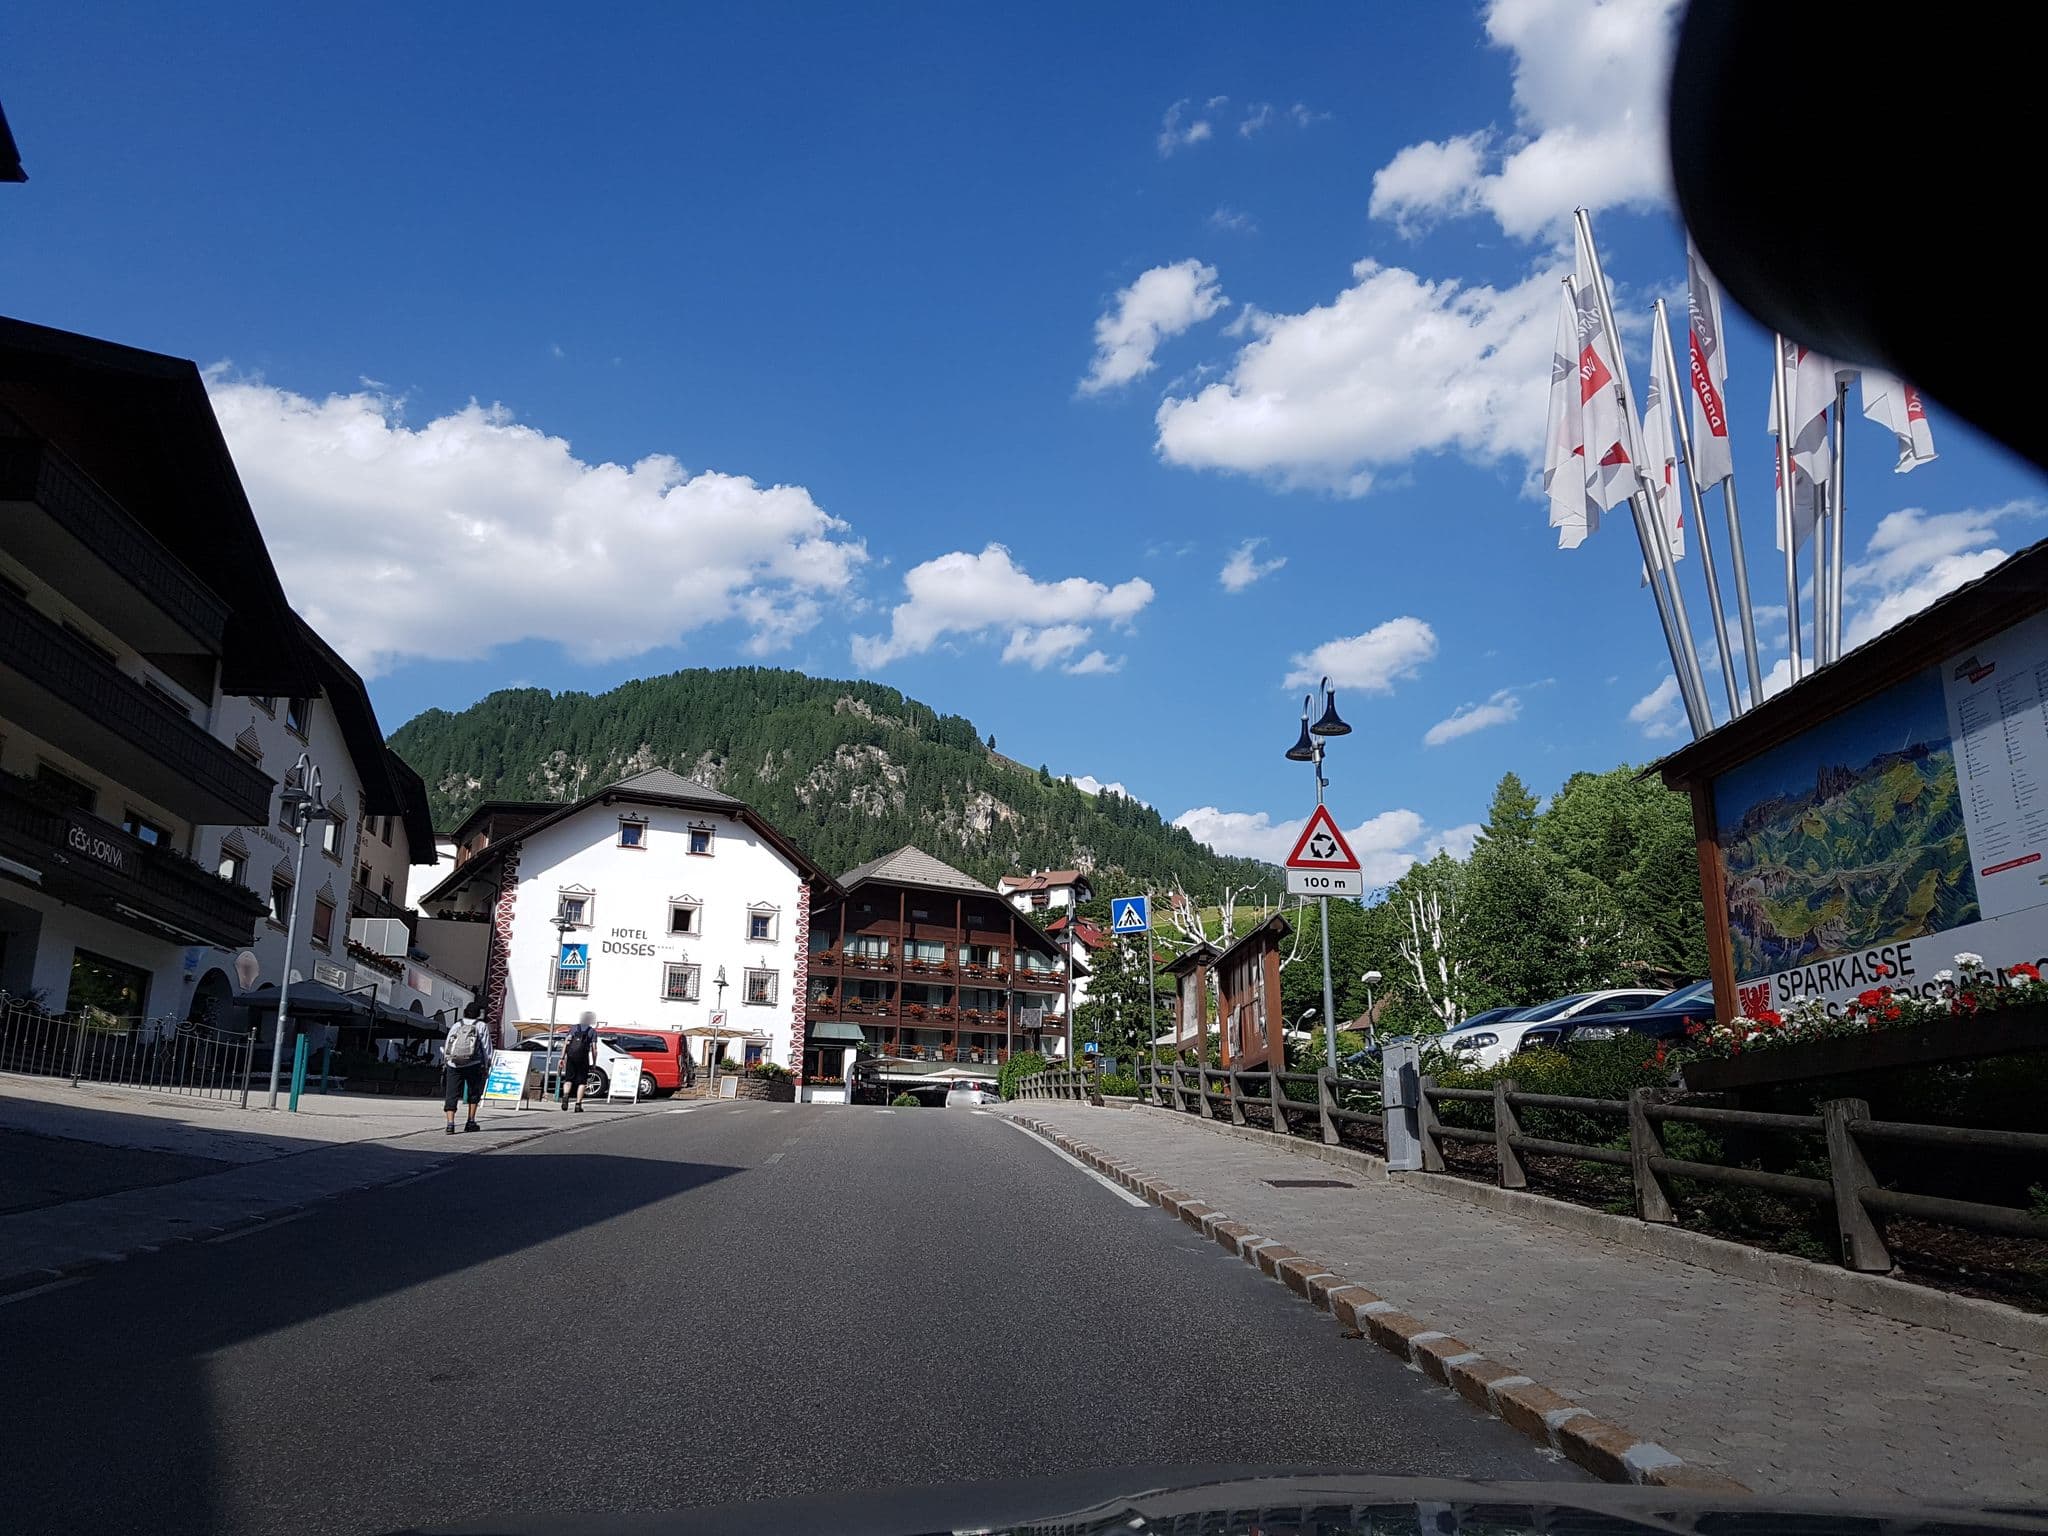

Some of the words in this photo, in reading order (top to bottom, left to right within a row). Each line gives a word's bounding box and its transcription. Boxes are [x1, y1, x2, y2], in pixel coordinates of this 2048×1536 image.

[1304, 877, 1329, 888] 100
[1334, 880, 1346, 888] m
[611, 927, 648, 940] HOTEL
[602, 940, 656, 957] DOSSES
[1777, 942, 1915, 1002] SPARKASSE
